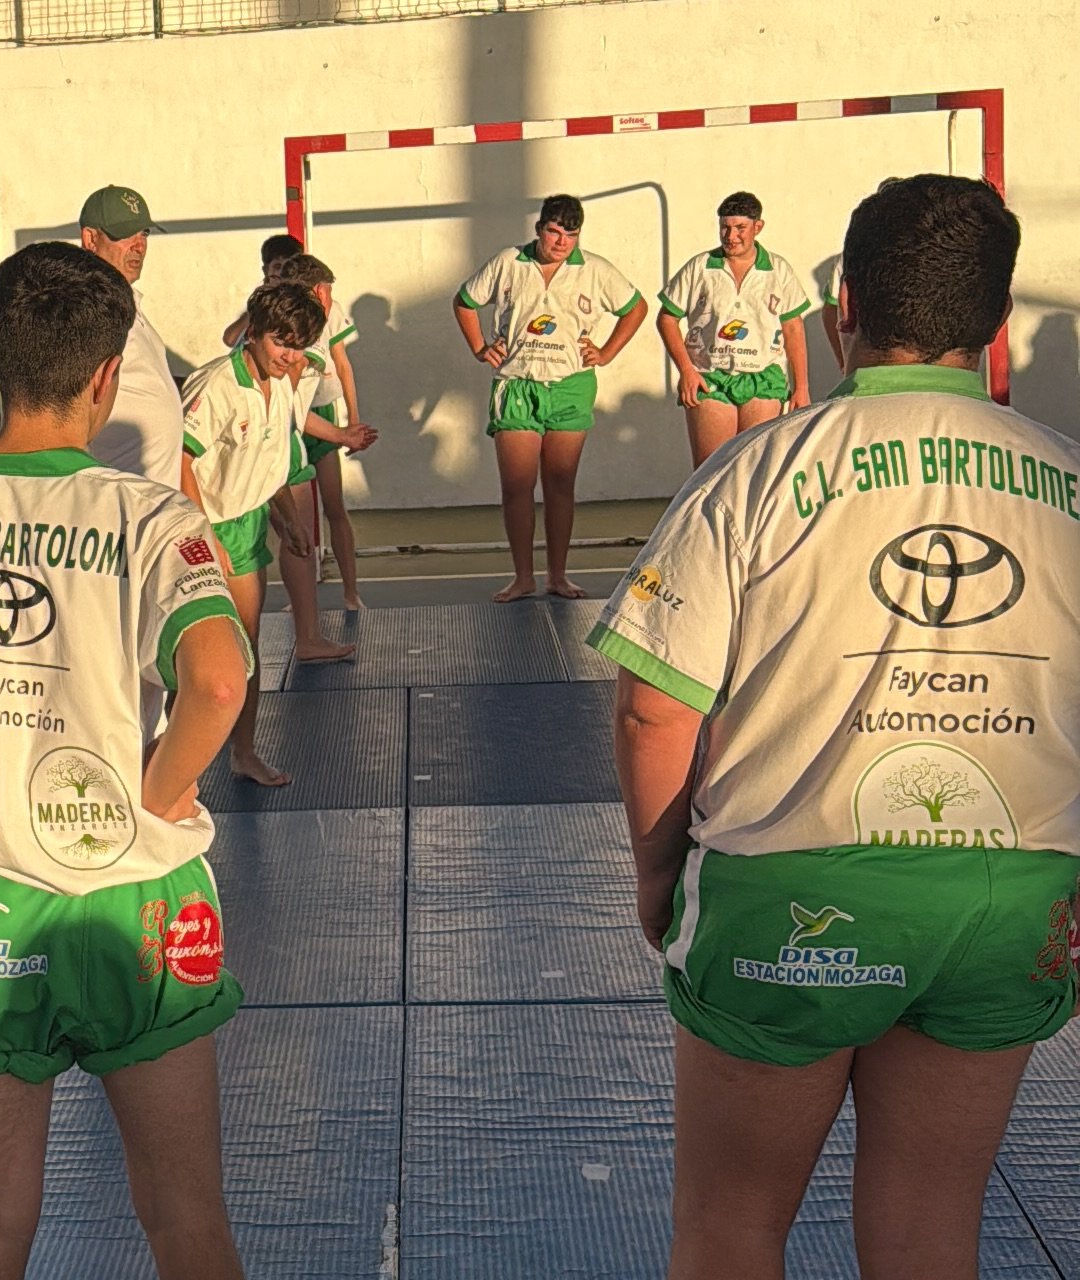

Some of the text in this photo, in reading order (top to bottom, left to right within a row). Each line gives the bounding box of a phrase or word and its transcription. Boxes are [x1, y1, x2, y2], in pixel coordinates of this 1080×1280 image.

[793, 437, 1080, 521] C.L. SAN BARTOLOME
[174, 566, 222, 588] Cabildo
[888, 665, 989, 698] Faycan
[846, 706, 1036, 735] Automoción
[37, 801, 128, 824] MADERAS
[824, 966, 904, 985] MOZAGA
